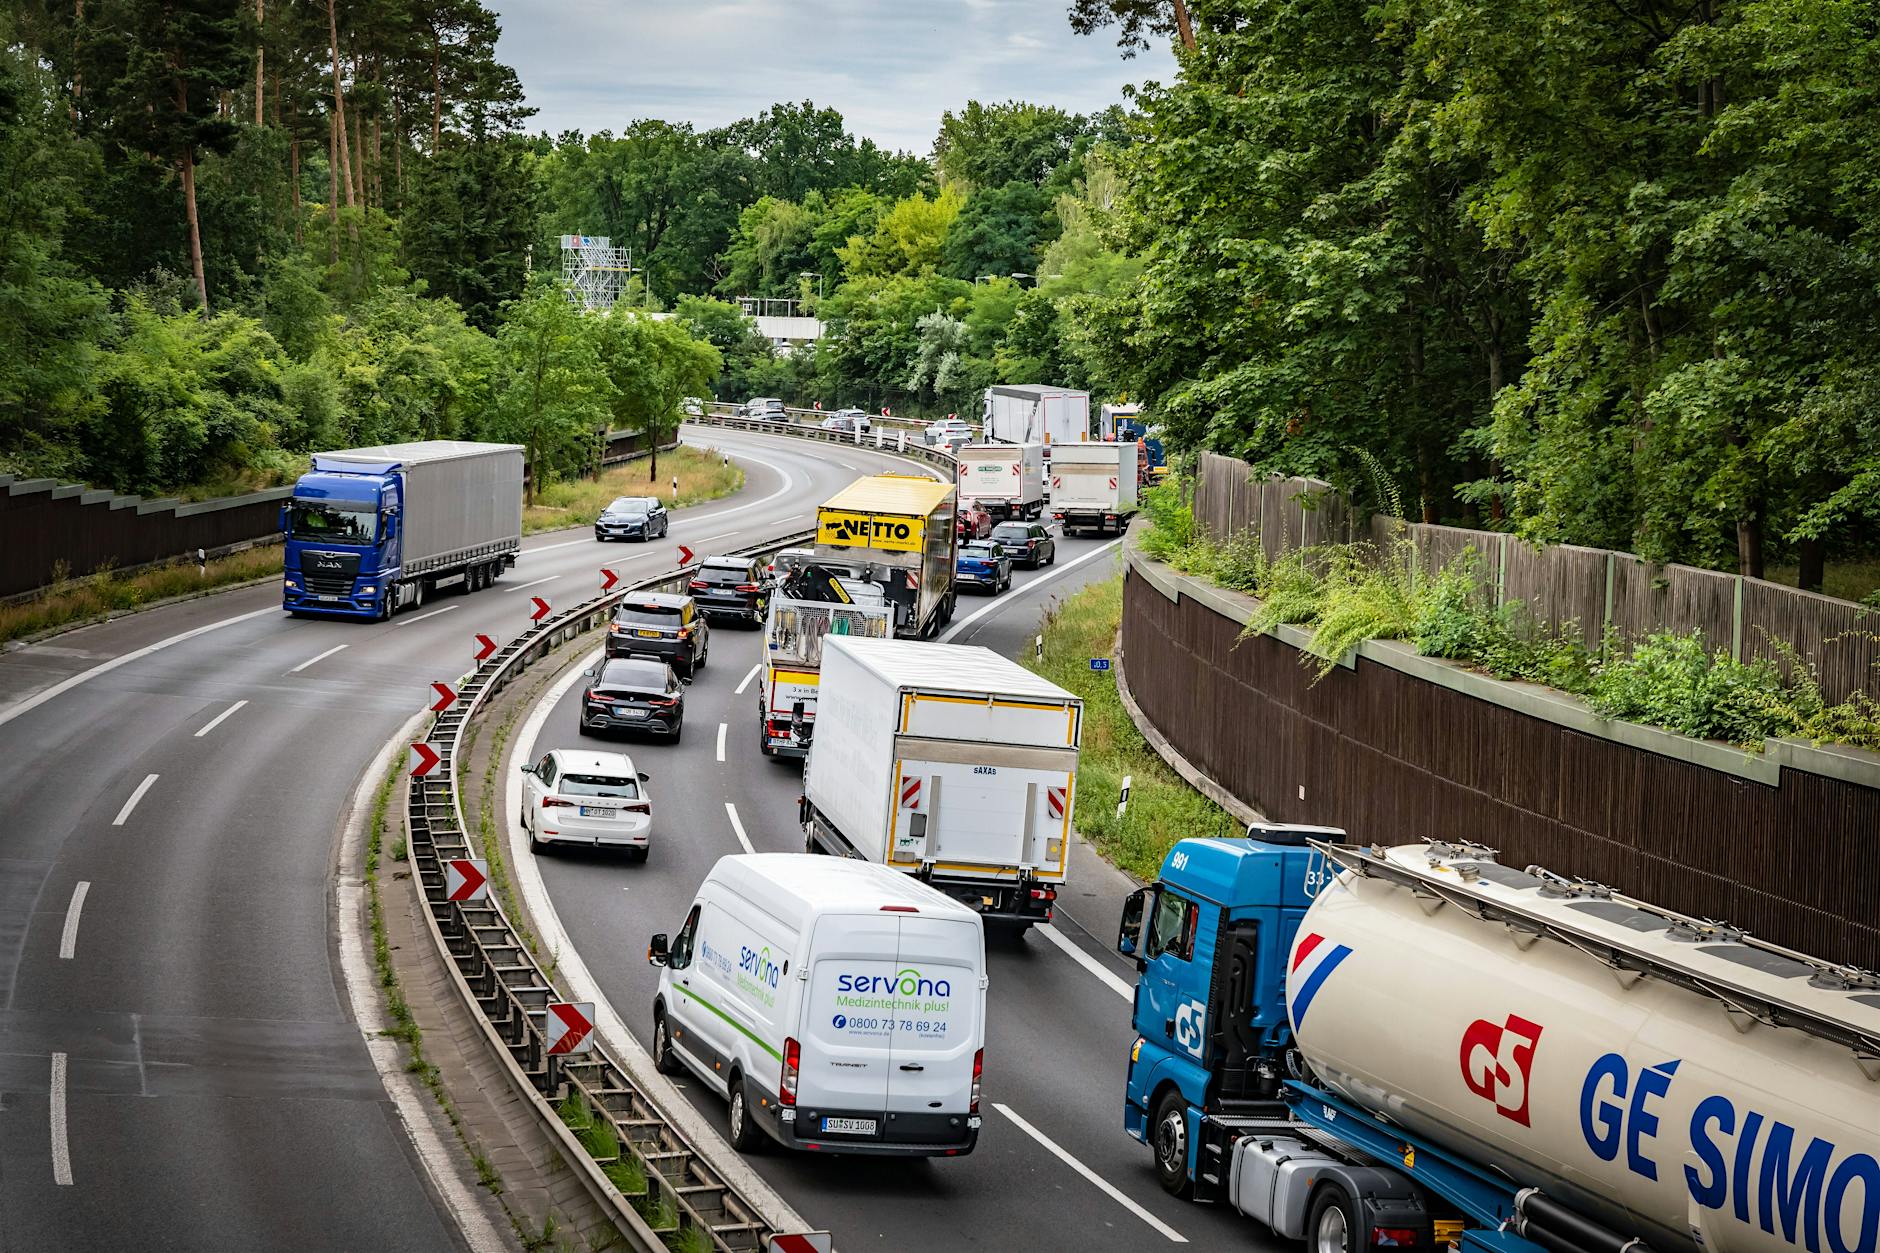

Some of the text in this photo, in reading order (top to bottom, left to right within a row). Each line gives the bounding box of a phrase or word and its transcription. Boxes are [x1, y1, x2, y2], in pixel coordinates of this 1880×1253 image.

[844, 519, 910, 539] NETTO
[1171, 851, 1190, 871] 991
[739, 945, 779, 990] servona
[838, 969, 951, 997] servona
[836, 995, 950, 1014] Medizintechnik plus!
[849, 1017, 947, 1033] 0800 73 78 69 24
[828, 1119, 839, 1129] SU
[843, 1120, 854, 1130] SV
[1579, 1052, 1682, 1182] GÉ
